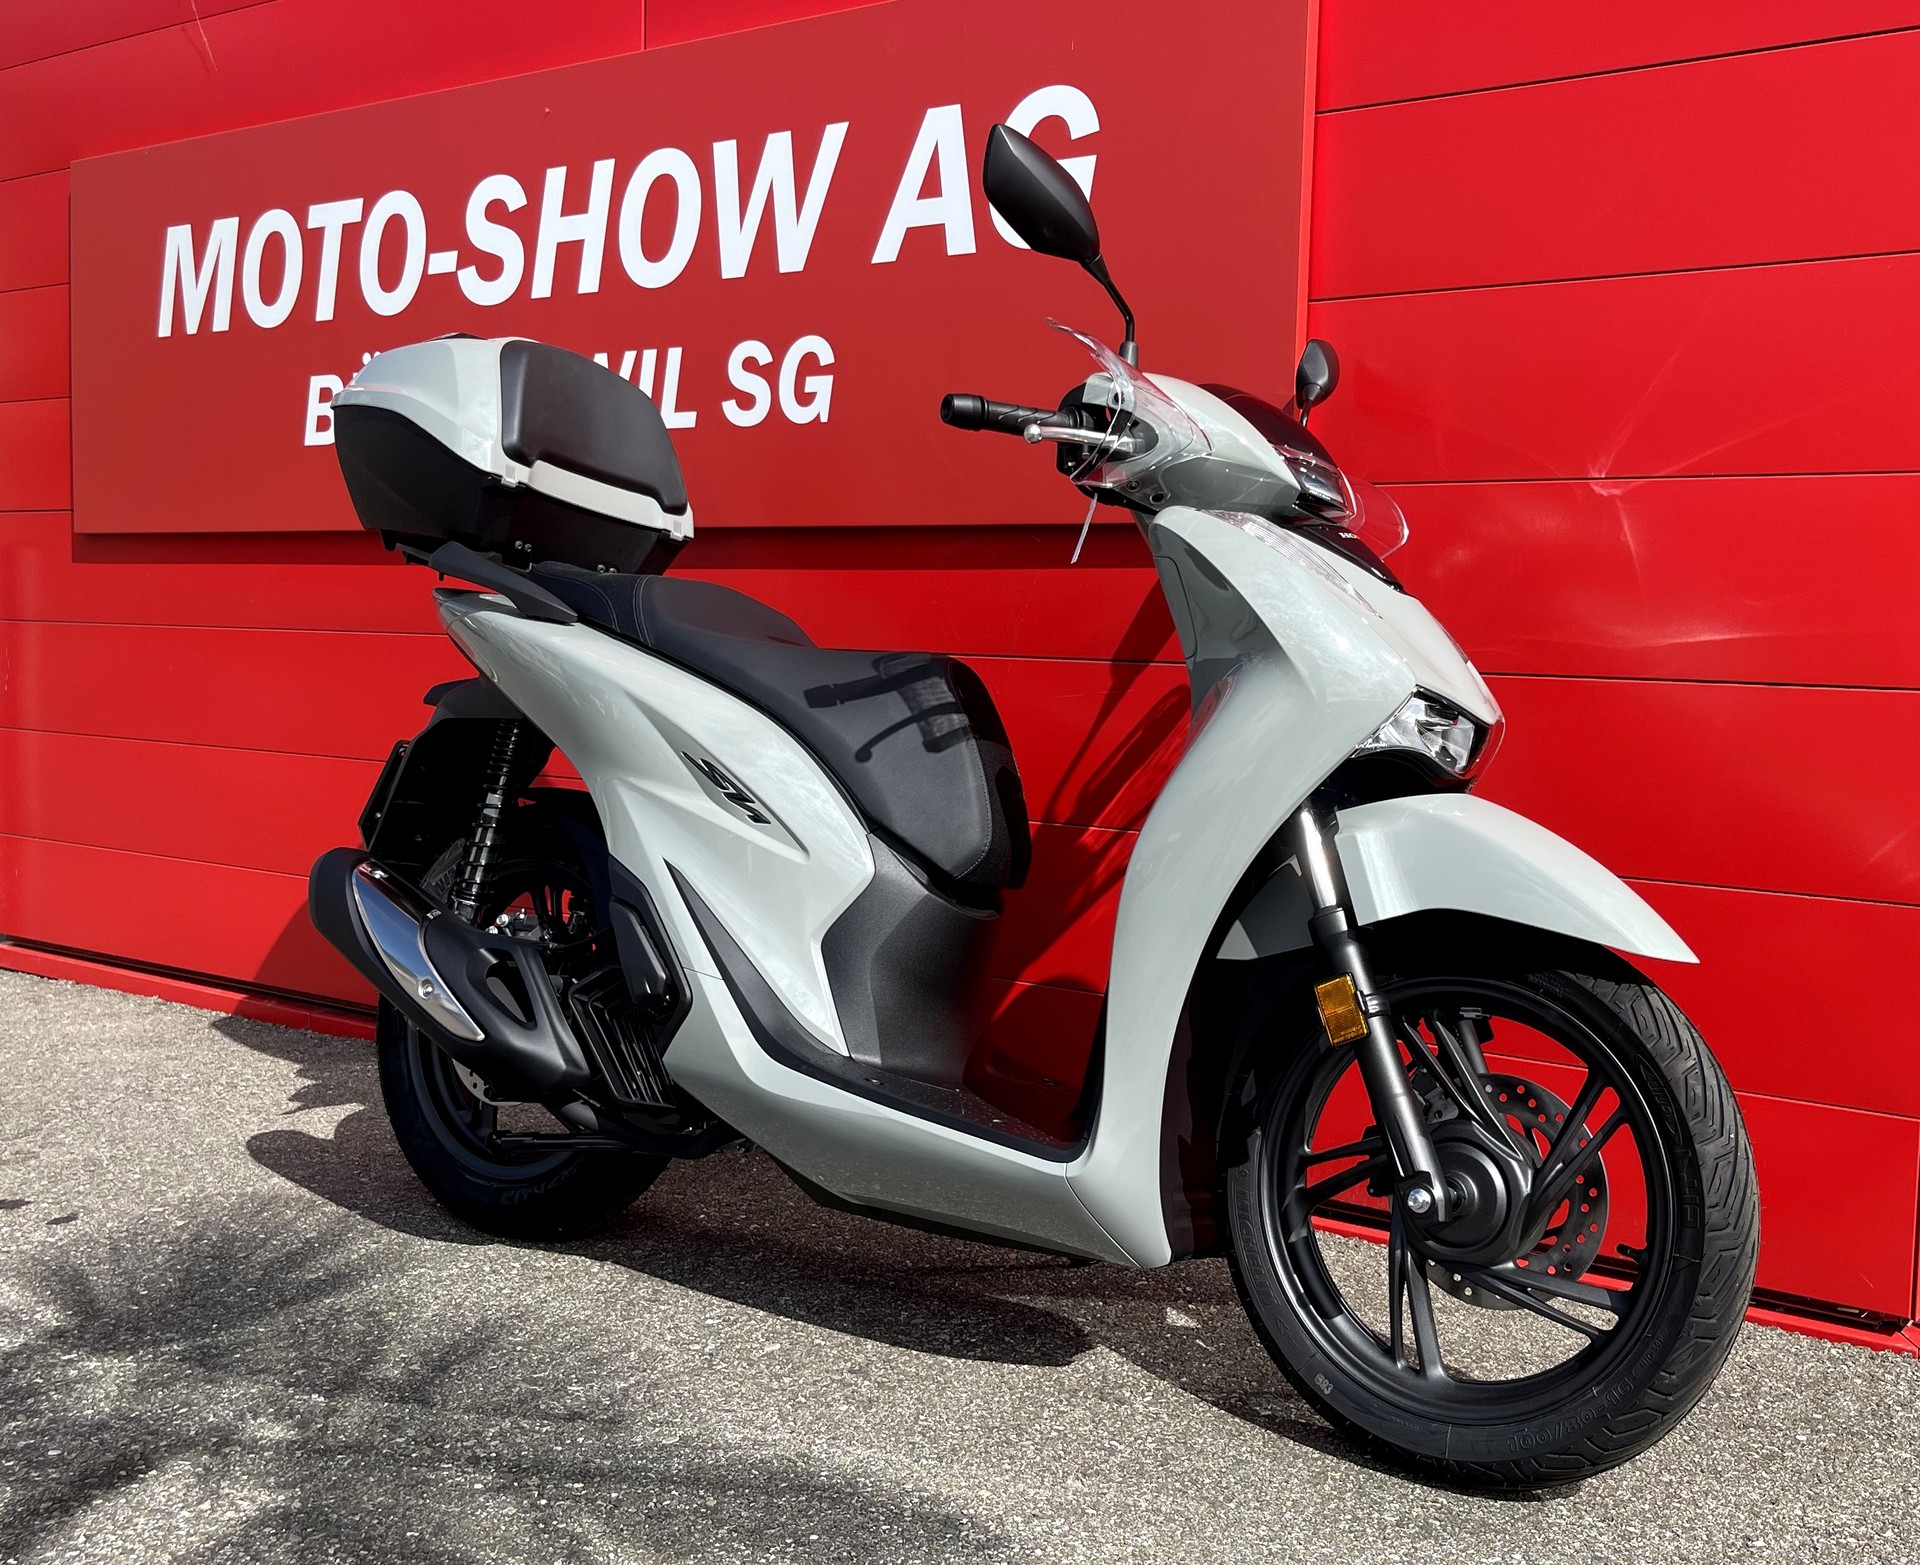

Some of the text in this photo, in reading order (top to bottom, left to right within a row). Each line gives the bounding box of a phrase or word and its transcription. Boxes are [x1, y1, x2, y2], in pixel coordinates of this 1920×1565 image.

[158, 84, 1100, 338] MOTO-SHOW AG
[721, 335, 836, 427] SG
[1236, 1187, 1276, 1310] MICHELIN
